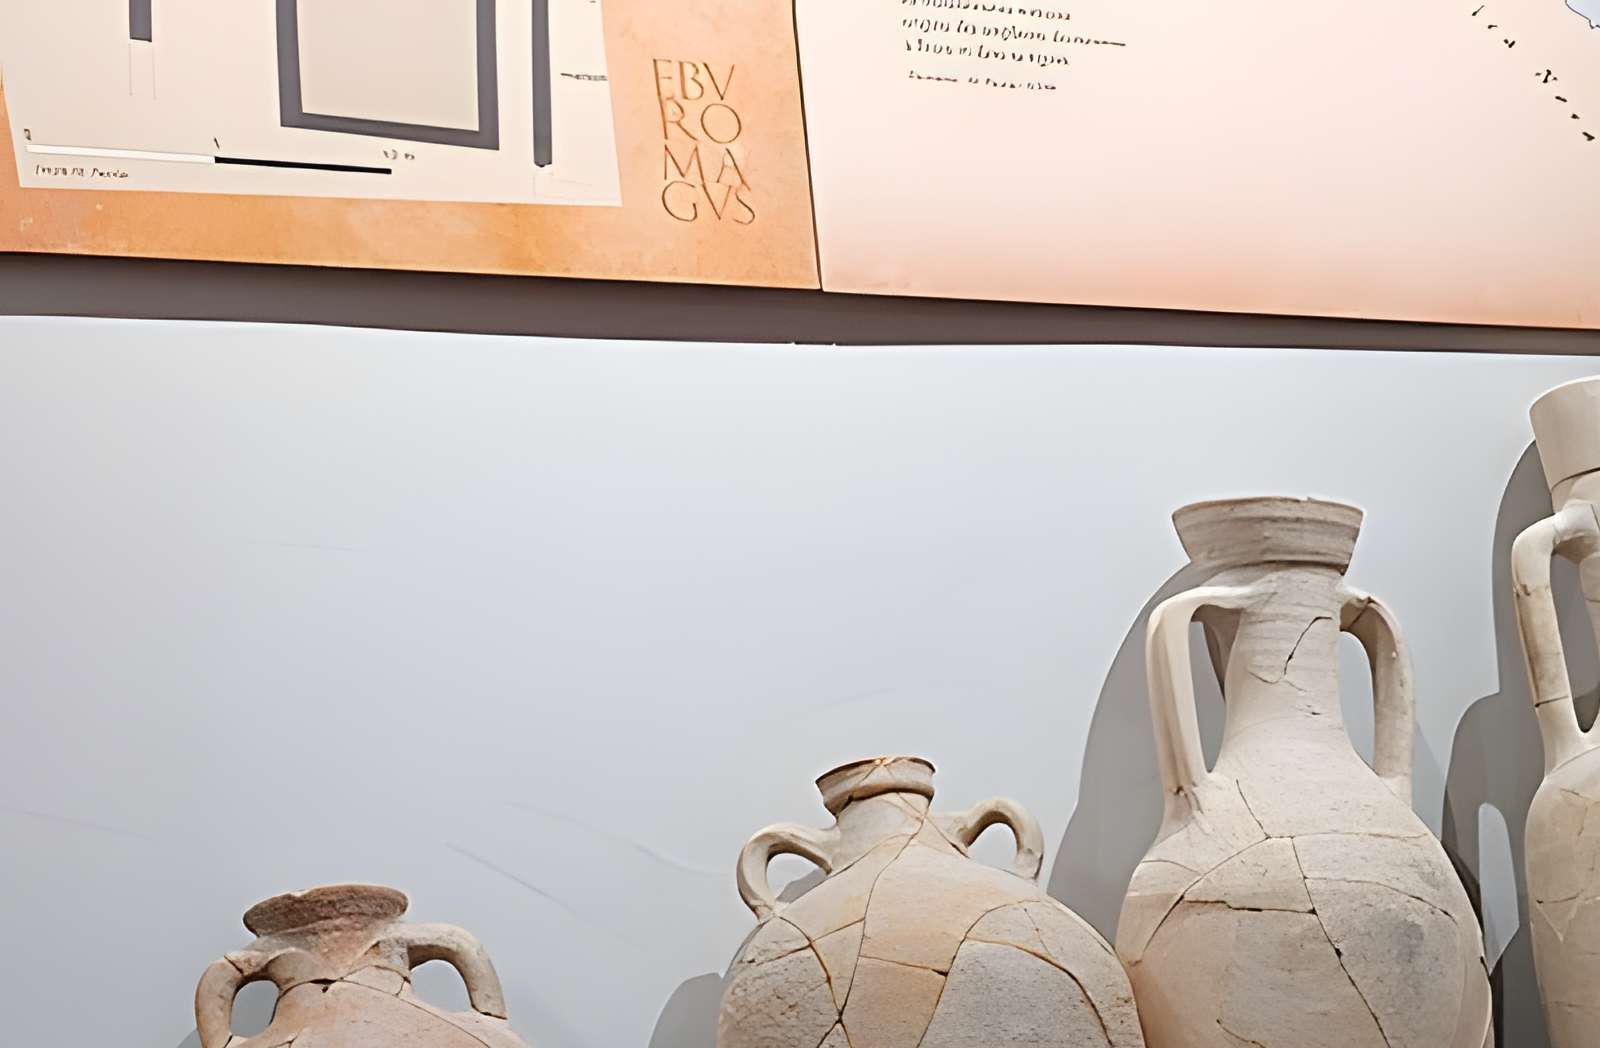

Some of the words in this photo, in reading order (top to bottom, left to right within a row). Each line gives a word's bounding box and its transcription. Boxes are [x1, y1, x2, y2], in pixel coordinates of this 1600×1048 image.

[652, 58, 735, 101] EBV
[658, 99, 742, 144] RO
[663, 143, 752, 192] MA
[661, 179, 756, 226] GVS
